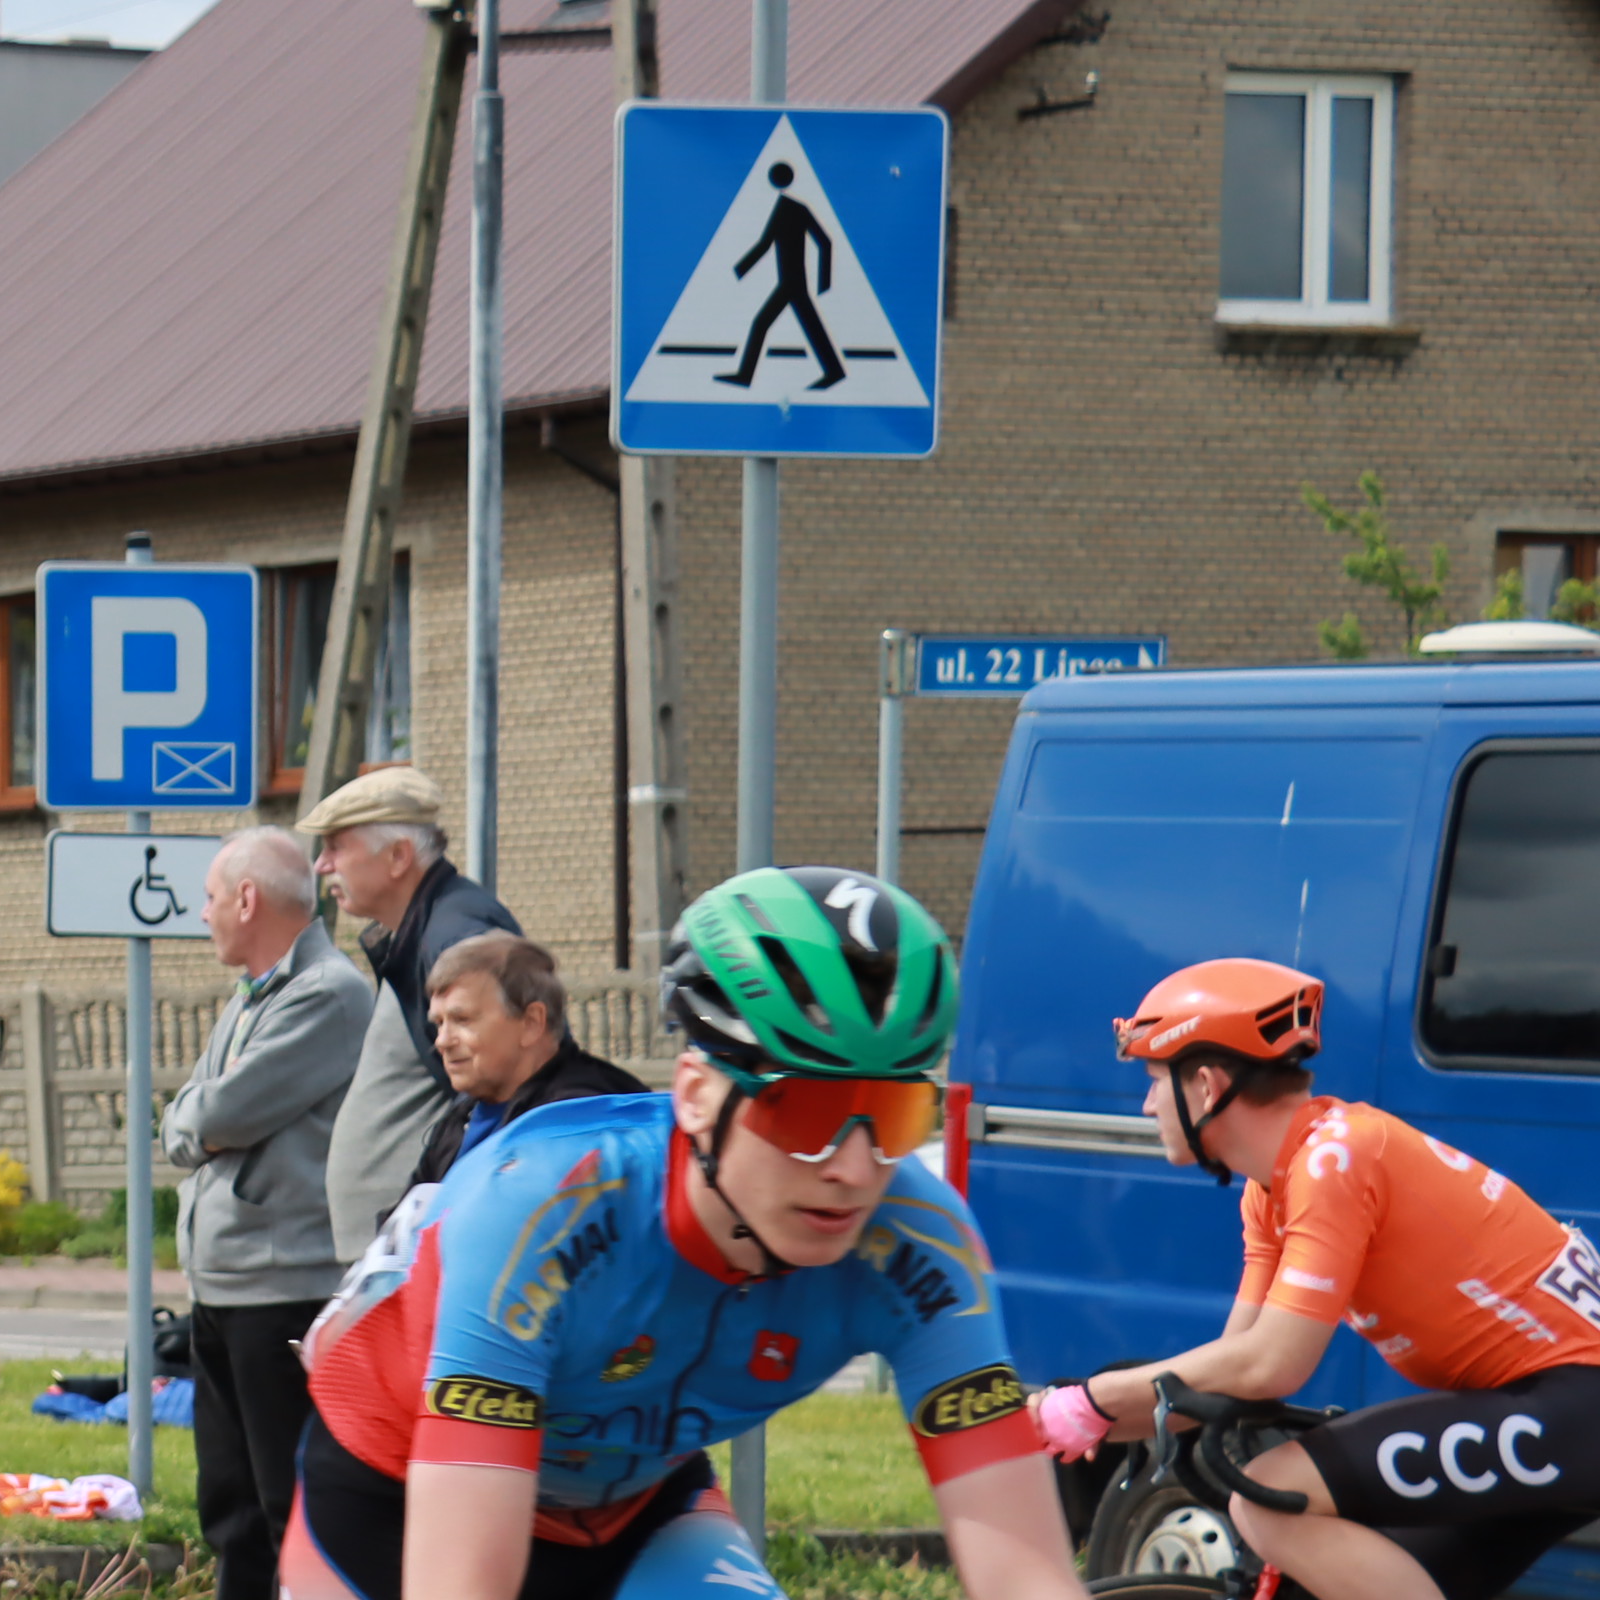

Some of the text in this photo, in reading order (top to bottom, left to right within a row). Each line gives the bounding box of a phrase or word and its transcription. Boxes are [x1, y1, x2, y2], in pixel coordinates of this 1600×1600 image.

[91, 595, 208, 781] P
[936, 648, 975, 683] ul.
[984, 648, 1022, 683] 22
[1456, 1278, 1558, 1344] GIANT
[1376, 1413, 1561, 1499] CCC
